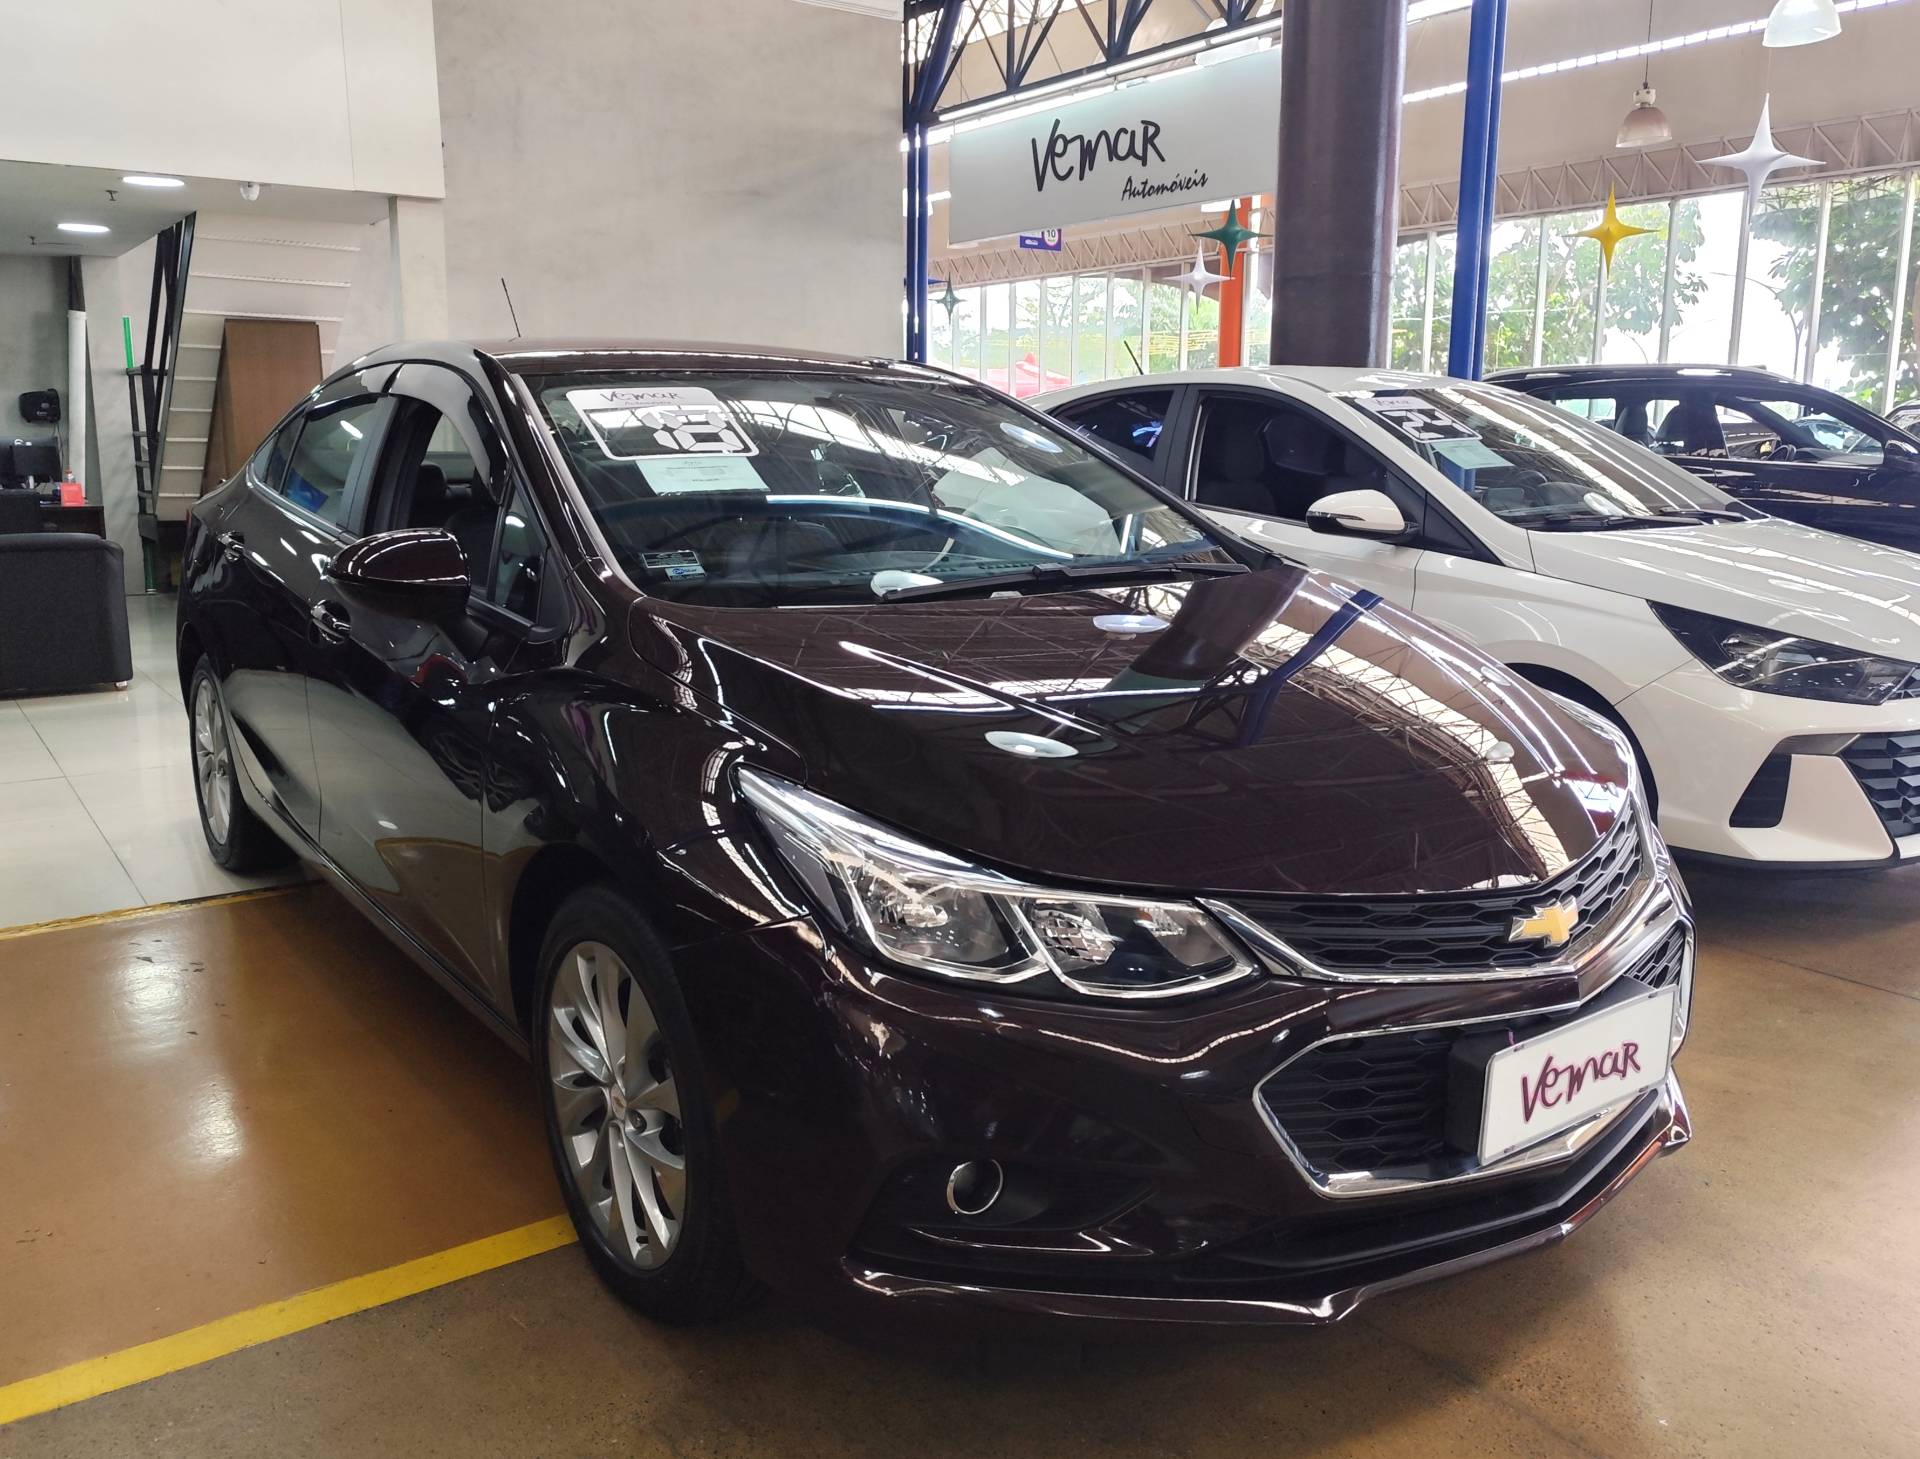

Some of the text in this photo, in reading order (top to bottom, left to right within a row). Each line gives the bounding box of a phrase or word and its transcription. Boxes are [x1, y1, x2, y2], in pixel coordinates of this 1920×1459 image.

[1121, 168, 1208, 201] Automóveis
[1046, 229, 1056, 238] 10
[641, 409, 745, 451] 18
